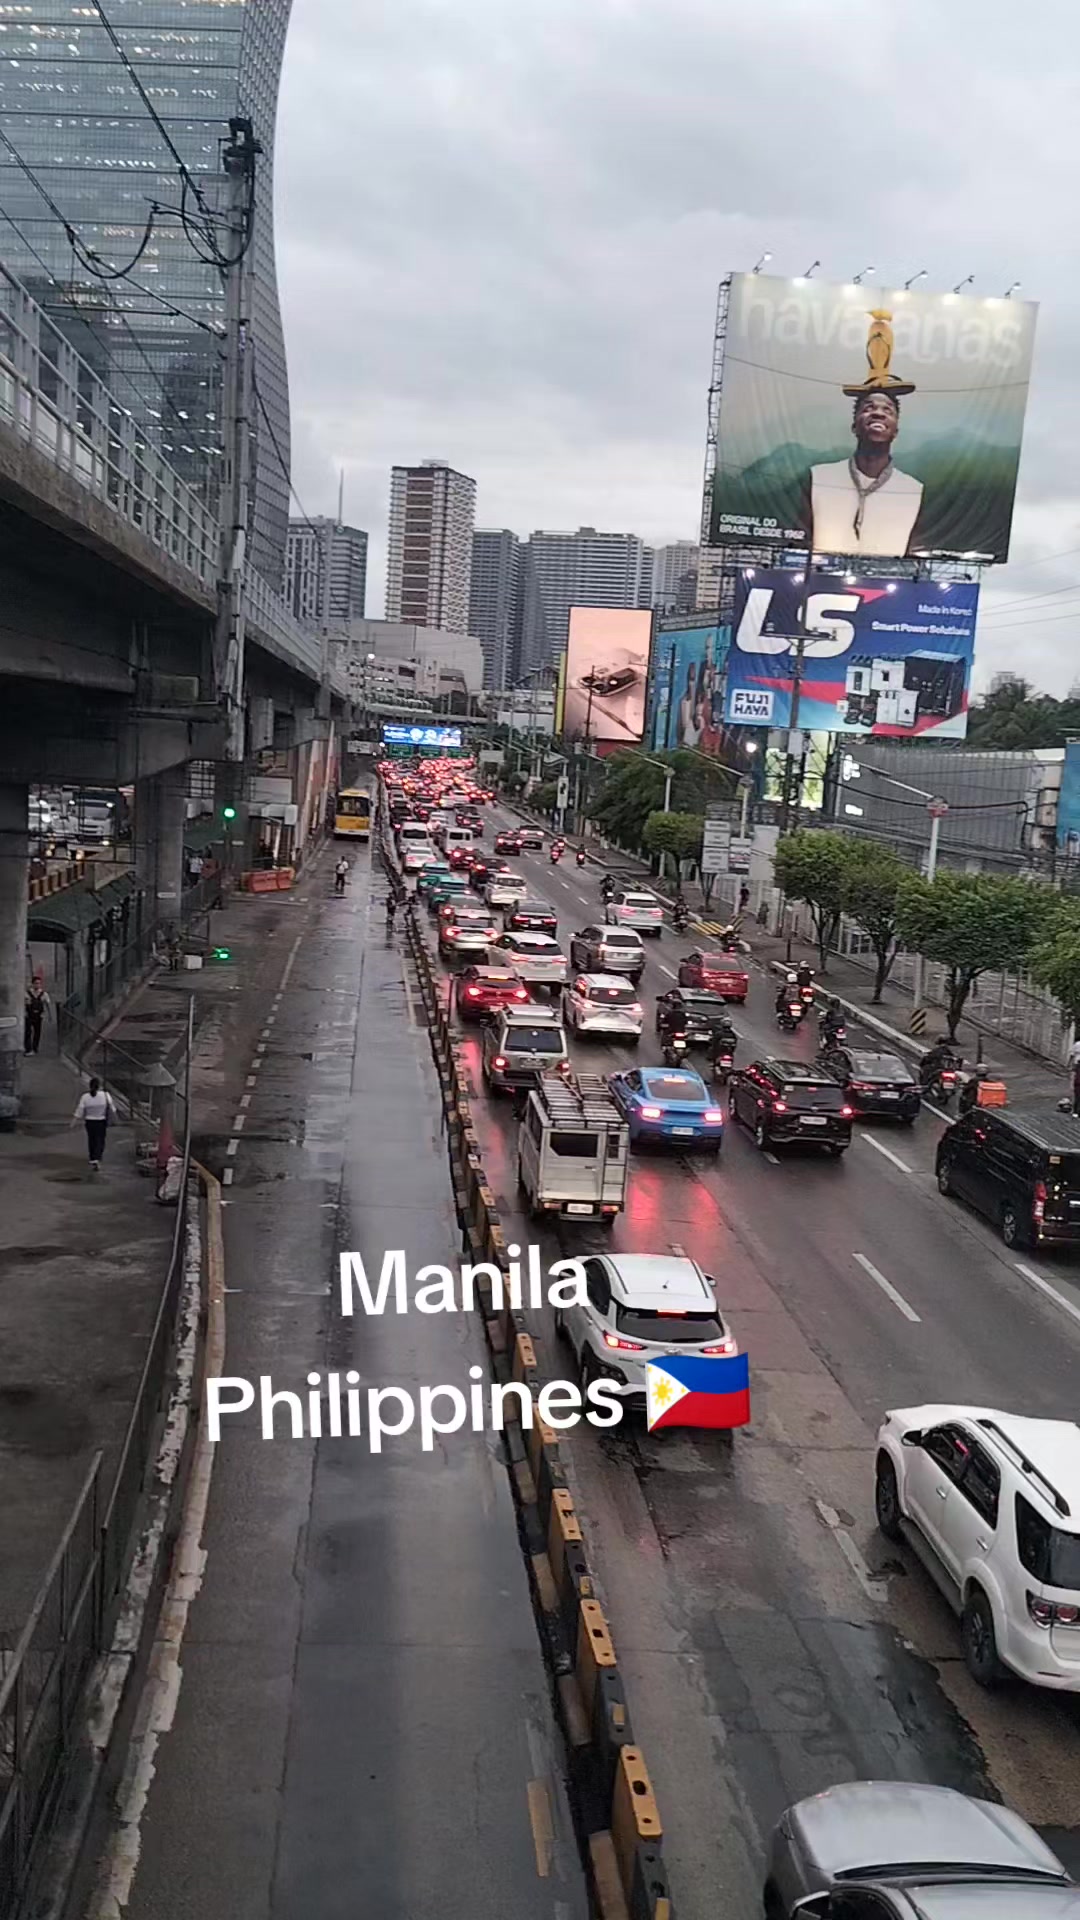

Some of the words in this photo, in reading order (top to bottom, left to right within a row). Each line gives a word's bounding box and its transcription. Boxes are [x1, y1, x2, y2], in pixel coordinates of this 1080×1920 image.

[742, 281, 1023, 368] havaanas
[720, 514, 761, 527] ORIGINAL
[763, 517, 777, 527] DO
[720, 524, 752, 536] BRASIL
[753, 527, 782, 538] DESDE
[918, 604, 940, 614] Made
[736, 587, 861, 659] LS
[872, 621, 900, 632] Smart
[900, 623, 928, 633] Power
[929, 625, 970, 636] Solutions
[735, 692, 769, 705] FUJI
[734, 703, 769, 716] HAYA
